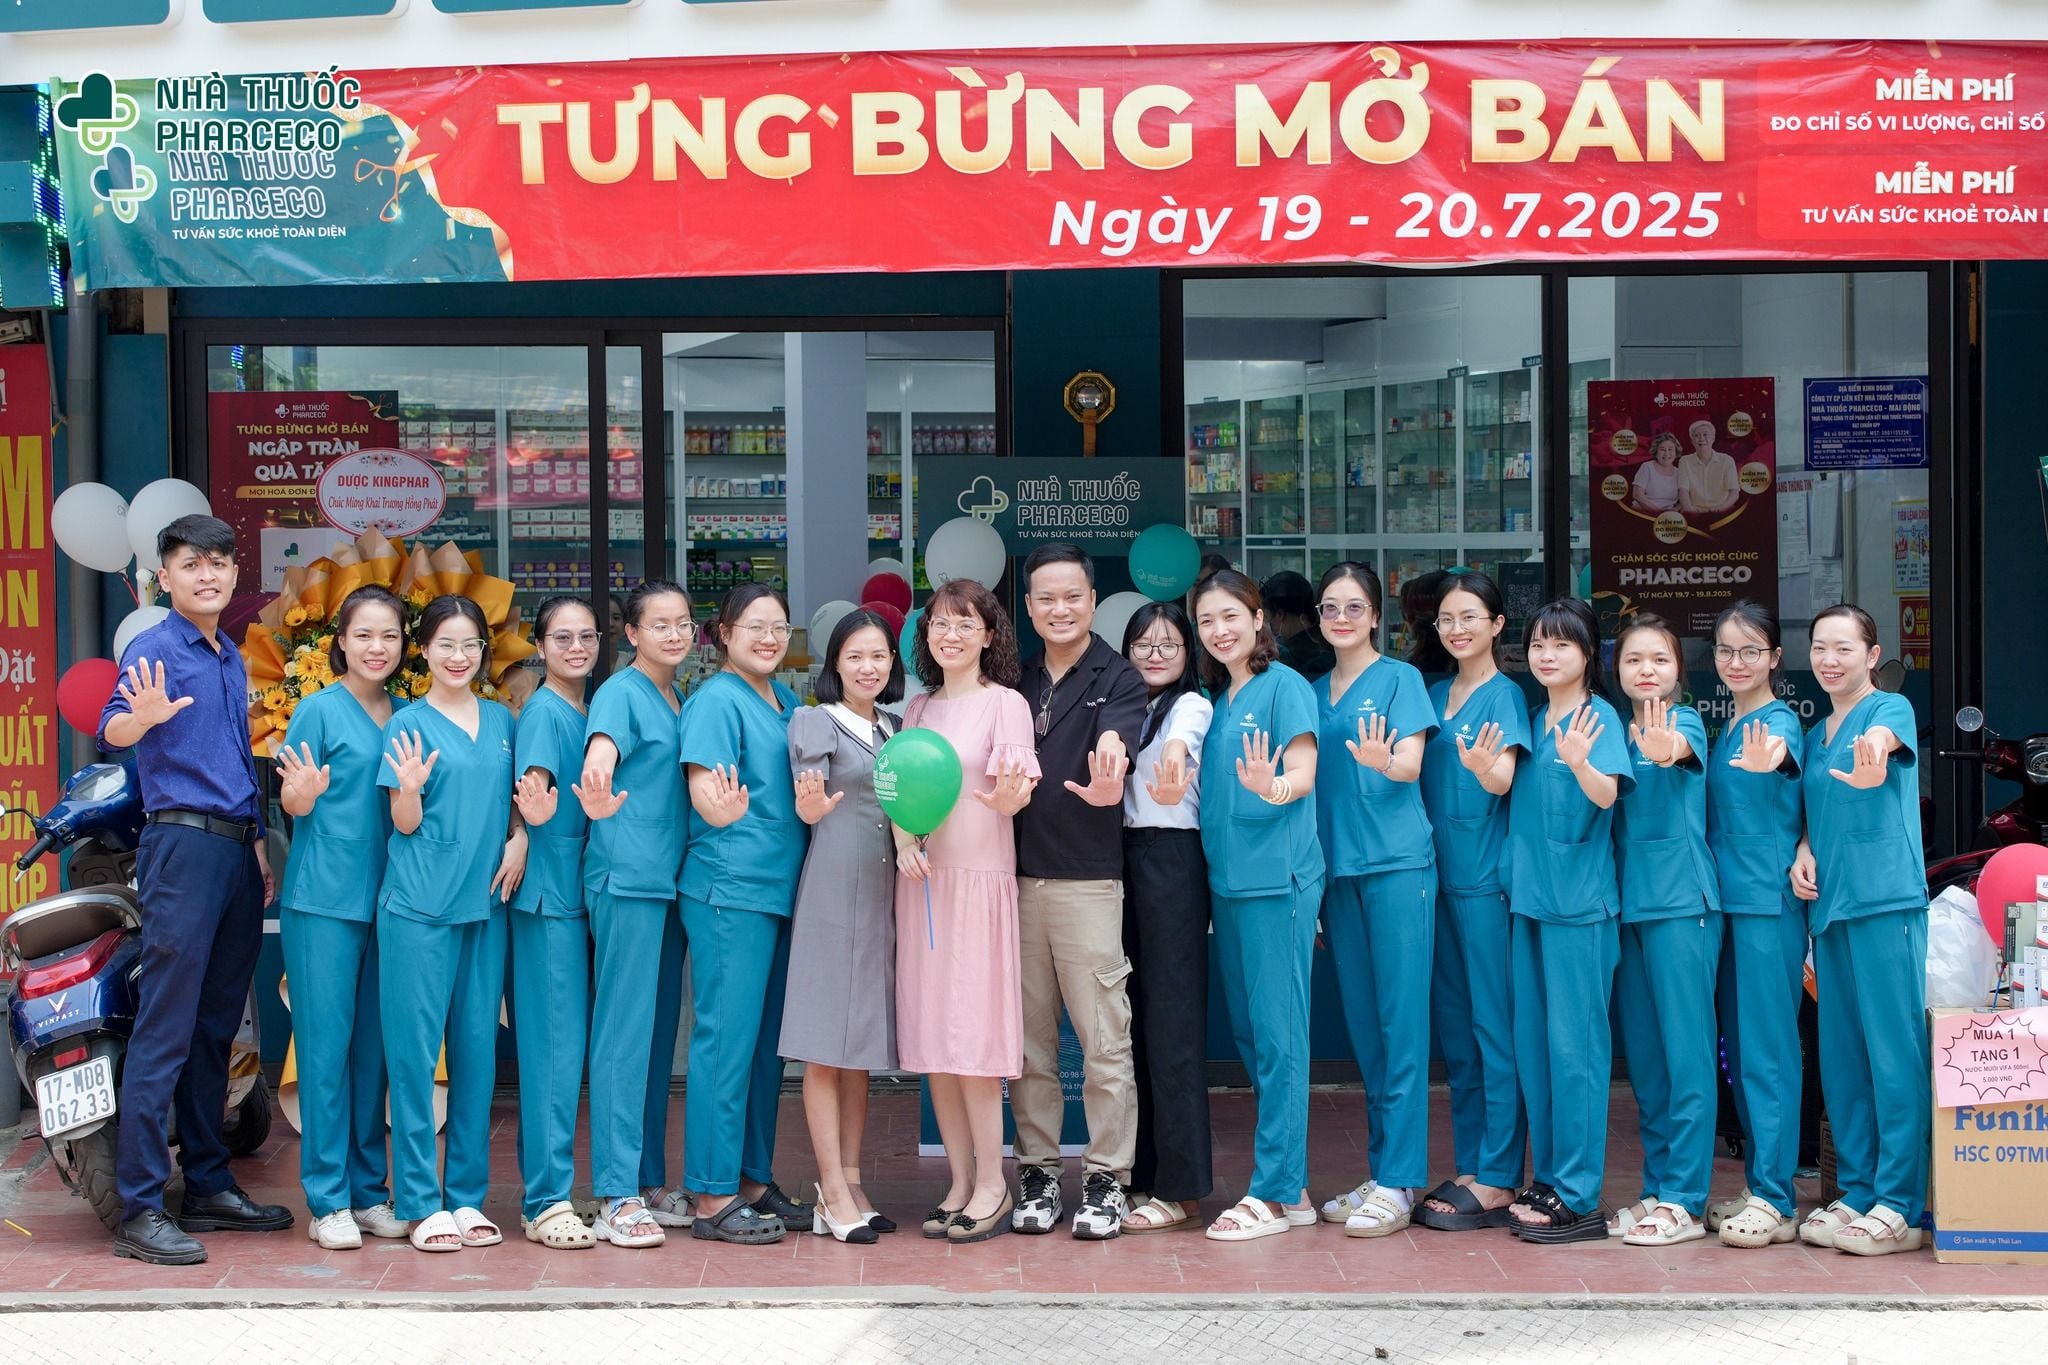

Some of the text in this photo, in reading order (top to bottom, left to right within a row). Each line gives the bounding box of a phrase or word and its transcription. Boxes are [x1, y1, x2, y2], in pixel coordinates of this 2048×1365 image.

[1875, 68, 2016, 101] MIỄN PHÍ
[496, 46, 1725, 184] TƯNG BỪNG MỞ BÁN
[1770, 111, 2045, 135] ĐO CHỈ SỐ VI LƯỢNG, CHỈ SỐ
[1875, 161, 2018, 194] MIỄN PHÍ
[170, 186, 326, 221] PHARCECO
[1802, 206, 1829, 223] TƯ
[1832, 204, 1873, 223] VẤN
[1879, 205, 1918, 223] SỨC
[1983, 205, 2038, 222] TOÀN
[172, 228, 189, 240] TƯ
[191, 225, 217, 240] VẤN
[219, 226, 244, 239] SỨC
[282, 225, 315, 238] TOÀN
[318, 225, 347, 240] DIỆN
[1049, 195, 1233, 257] Ngày
[1258, 194, 1322, 240] 19
[1396, 191, 1722, 239] 20.7.2025
[1849, 404, 1883, 412] PHARCECO
[237, 421, 369, 435] TƯNG BỪNG MỞ BÁN
[248, 437, 360, 459] NGẬP TRÀN
[255, 462, 298, 481] QUÀ
[372, 475, 430, 489] KINGPHAR
[1018, 472, 1140, 501] NHÀ THUỐC
[267, 487, 286, 496] HOÁ
[288, 487, 308, 497] ĐƠN
[328, 496, 345, 509] Chúc
[365, 496, 381, 508] Khai
[1018, 505, 1129, 526] PHARCECO
[1018, 530, 1029, 538] TƯ
[1031, 529, 1049, 538] VẤN
[1051, 529, 1068, 538] SỨC
[1095, 529, 1119, 538] TOÀN
[1611, 553, 1644, 564] CHĂM
[1646, 552, 1669, 563] SÓC
[1670, 551, 1693, 562] SỨC
[1728, 550, 1759, 560] CÙNG
[1619, 566, 1752, 586] PHARCECO
[1651, 590, 1673, 599] NGÀY
[38, 1009, 80, 1028] VINFAST
[1973, 1028, 2014, 1041] MUA 1
[2012, 1046, 2020, 1060] 1
[1983, 1076, 1998, 1084] 5.000
[44, 1088, 111, 1132] 062.33
[1954, 1145, 2048, 1163] HSC 09TM
